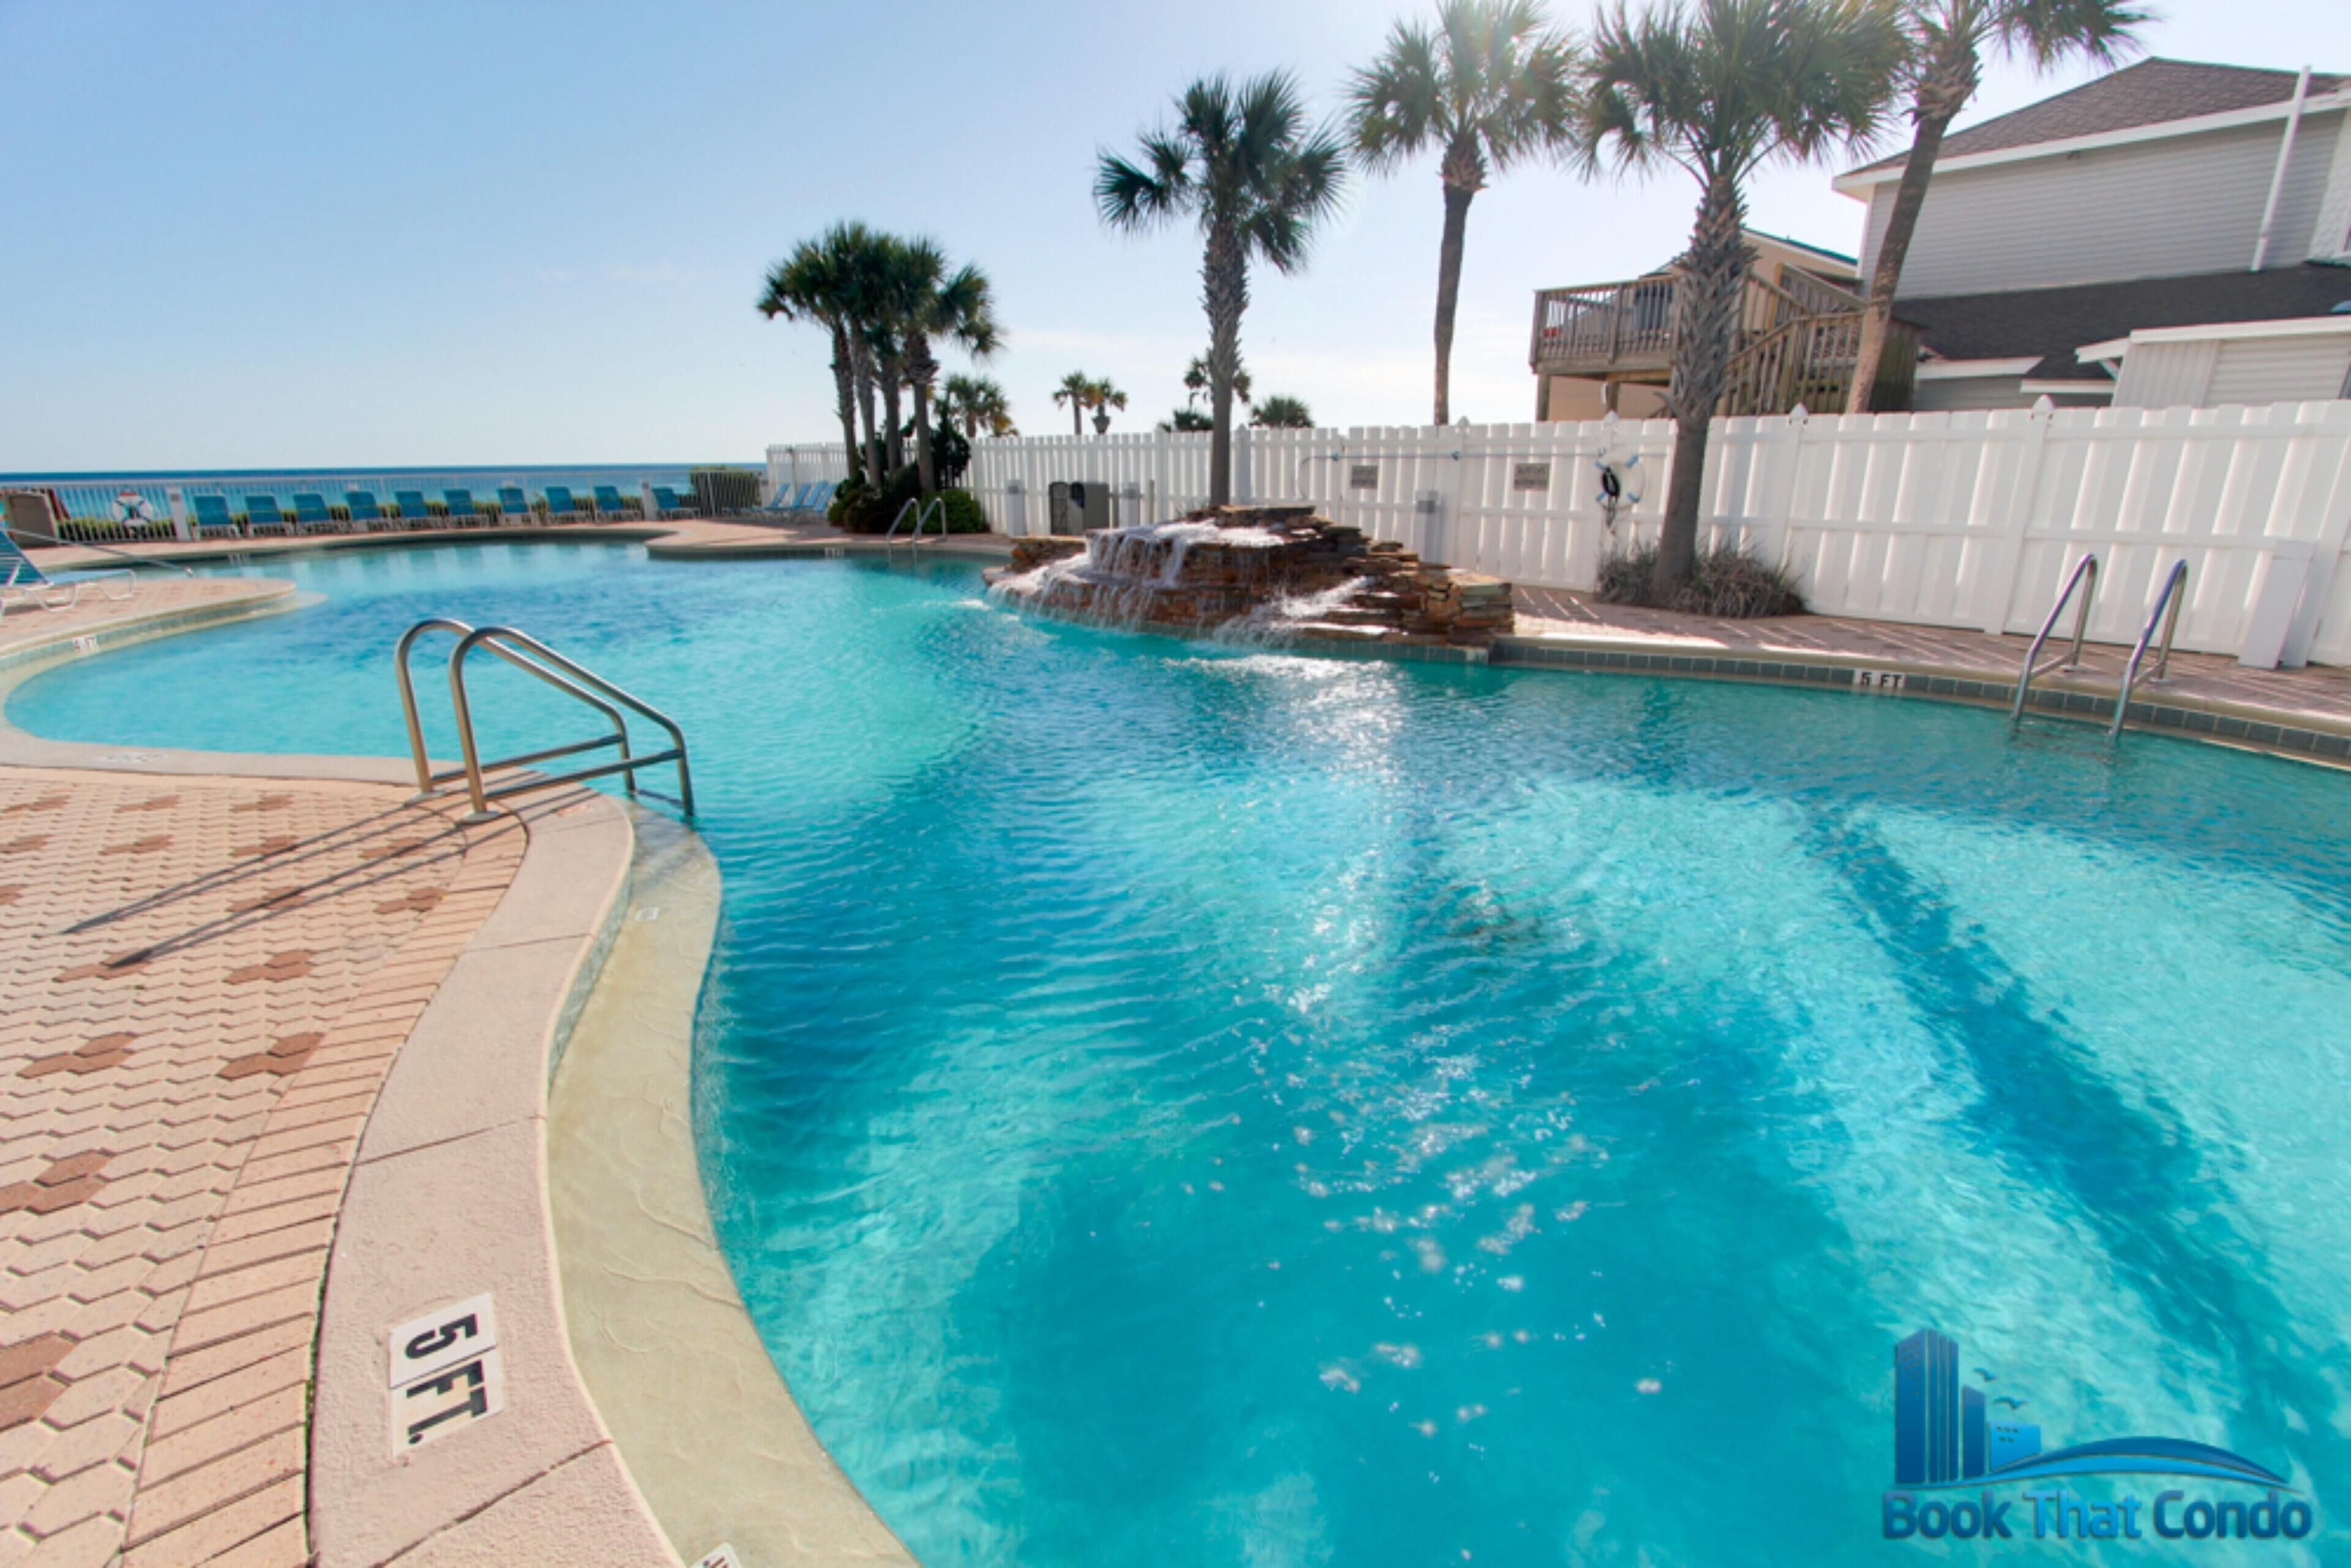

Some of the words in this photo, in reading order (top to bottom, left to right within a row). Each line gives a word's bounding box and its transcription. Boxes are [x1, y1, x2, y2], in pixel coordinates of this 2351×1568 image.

[1860, 672, 1872, 686] 5
[1880, 674, 1902, 688] FT
[405, 1313, 478, 1359] 5
[406, 1359, 487, 1444] FT.
